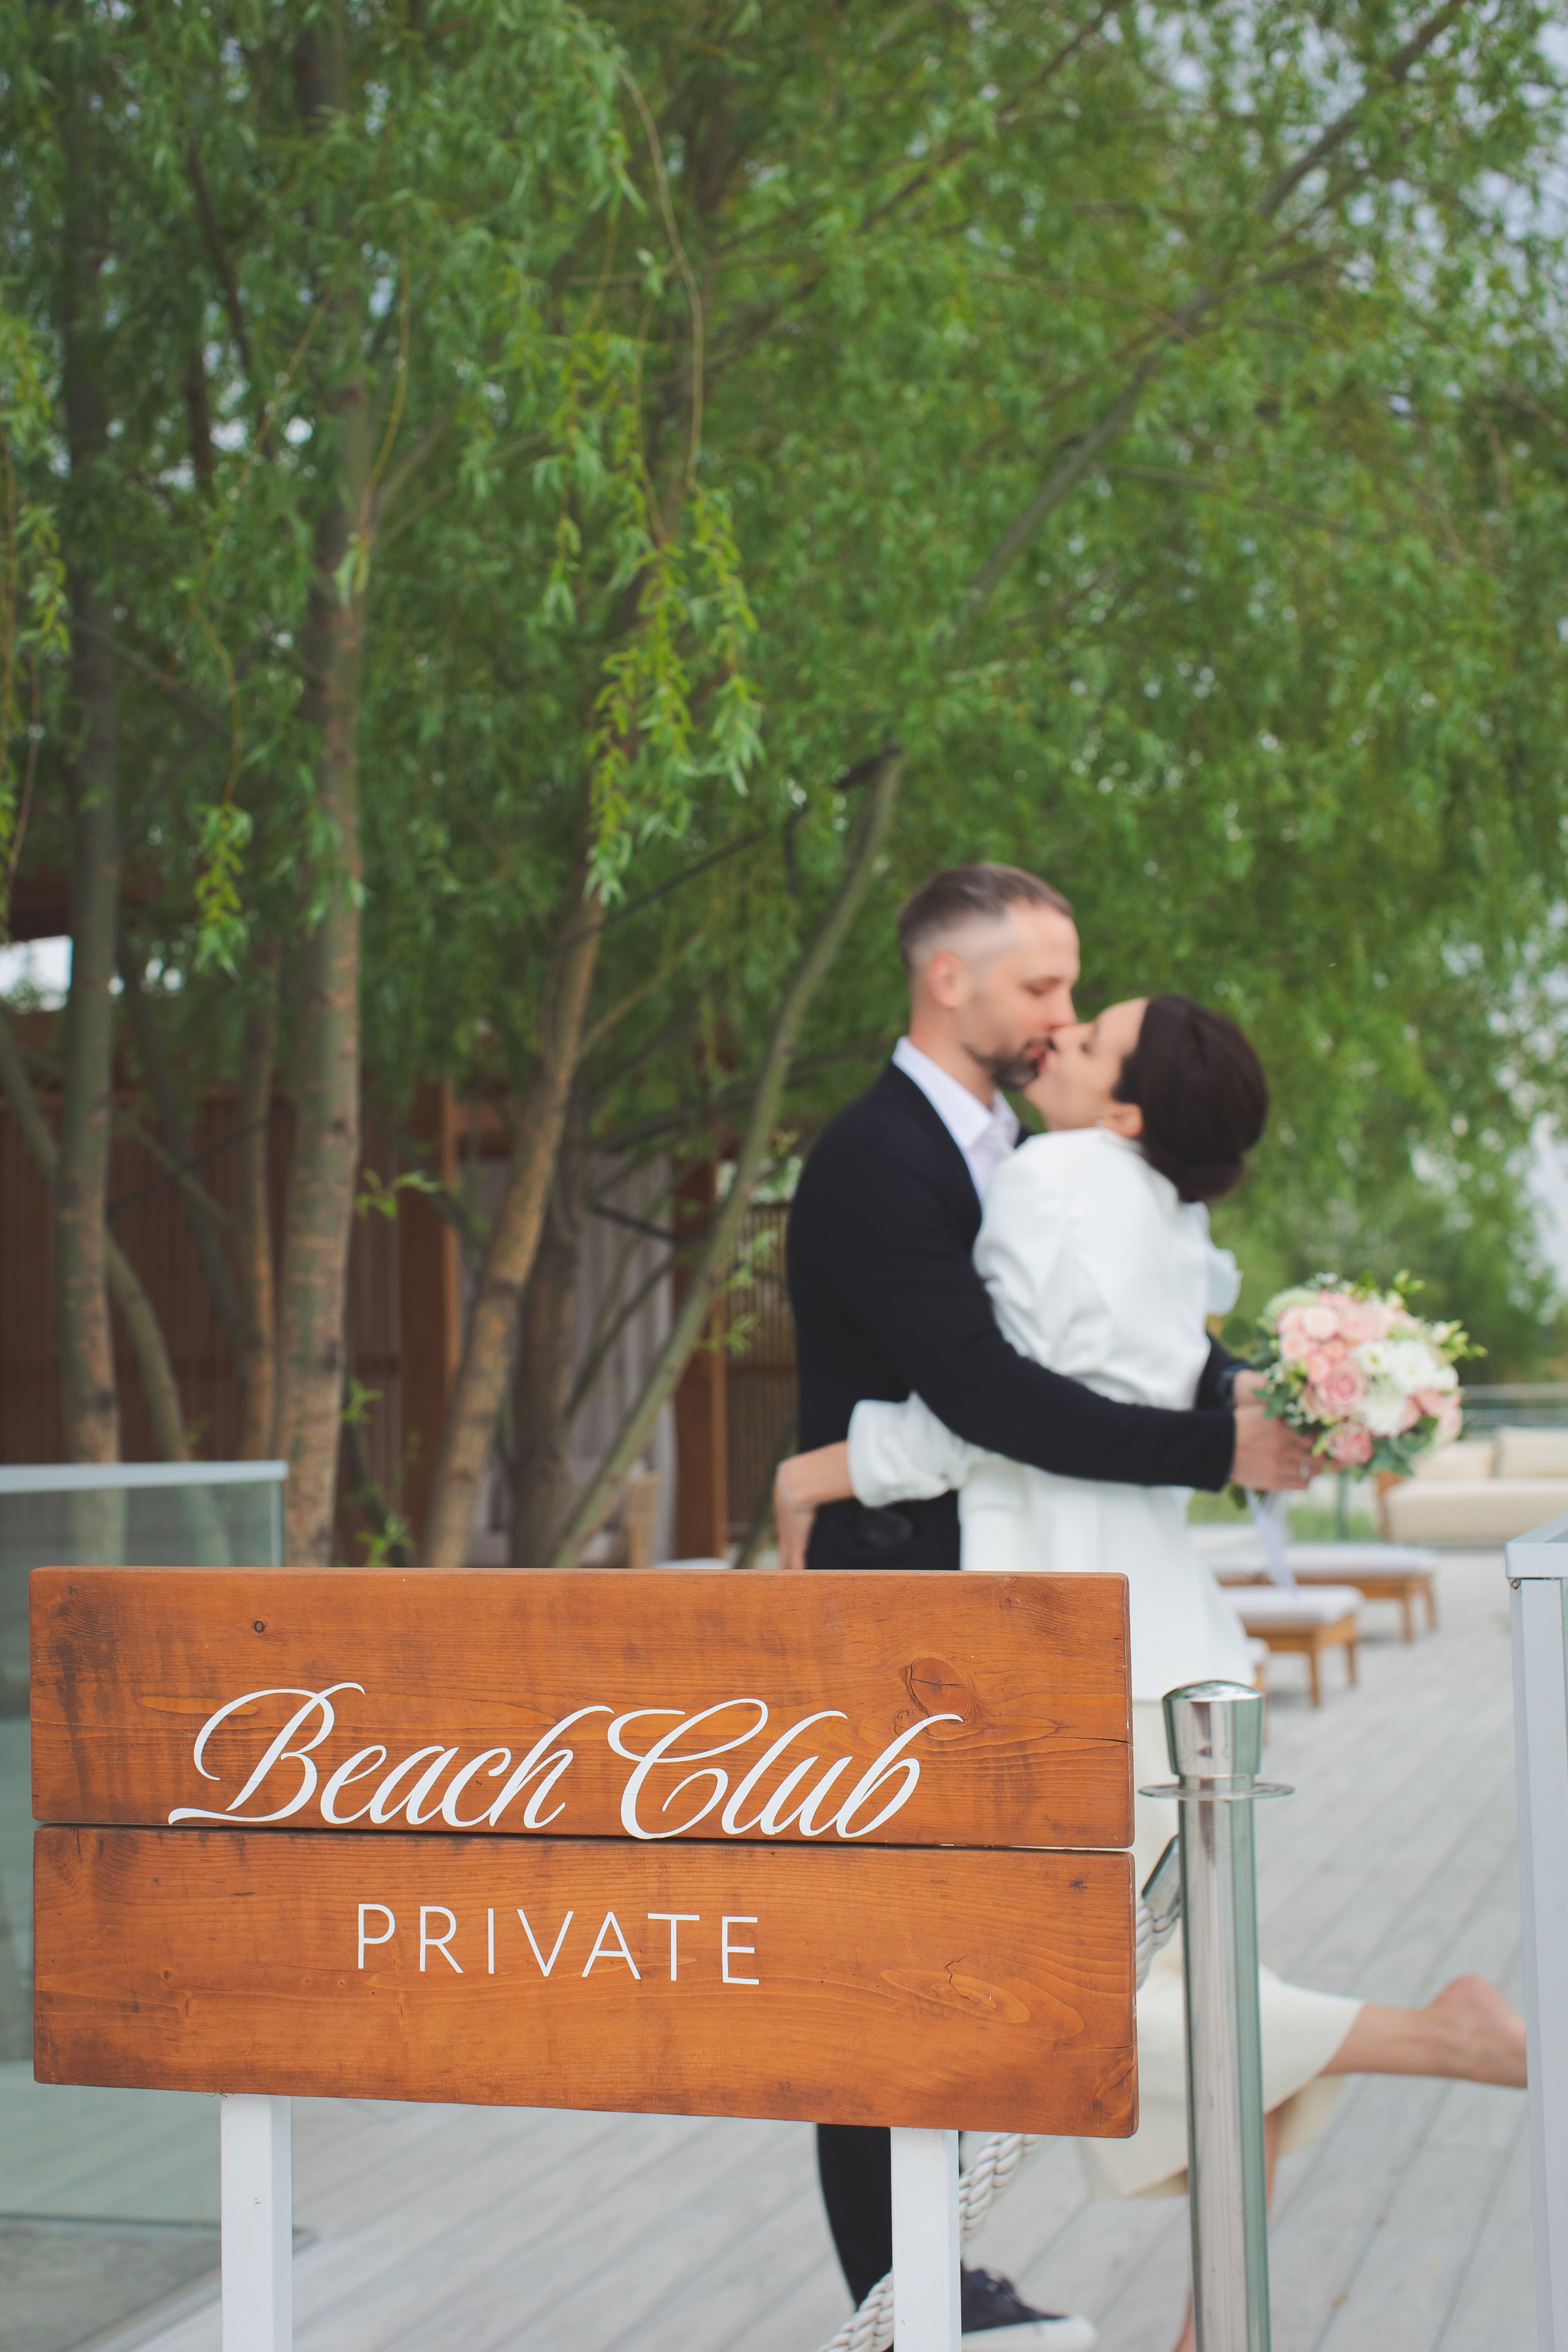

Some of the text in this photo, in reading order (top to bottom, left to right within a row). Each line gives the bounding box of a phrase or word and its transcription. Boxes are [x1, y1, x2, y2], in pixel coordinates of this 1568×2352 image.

[168, 1682, 964, 1841] Beach Club
[358, 1903, 760, 1986] PRIVATE
